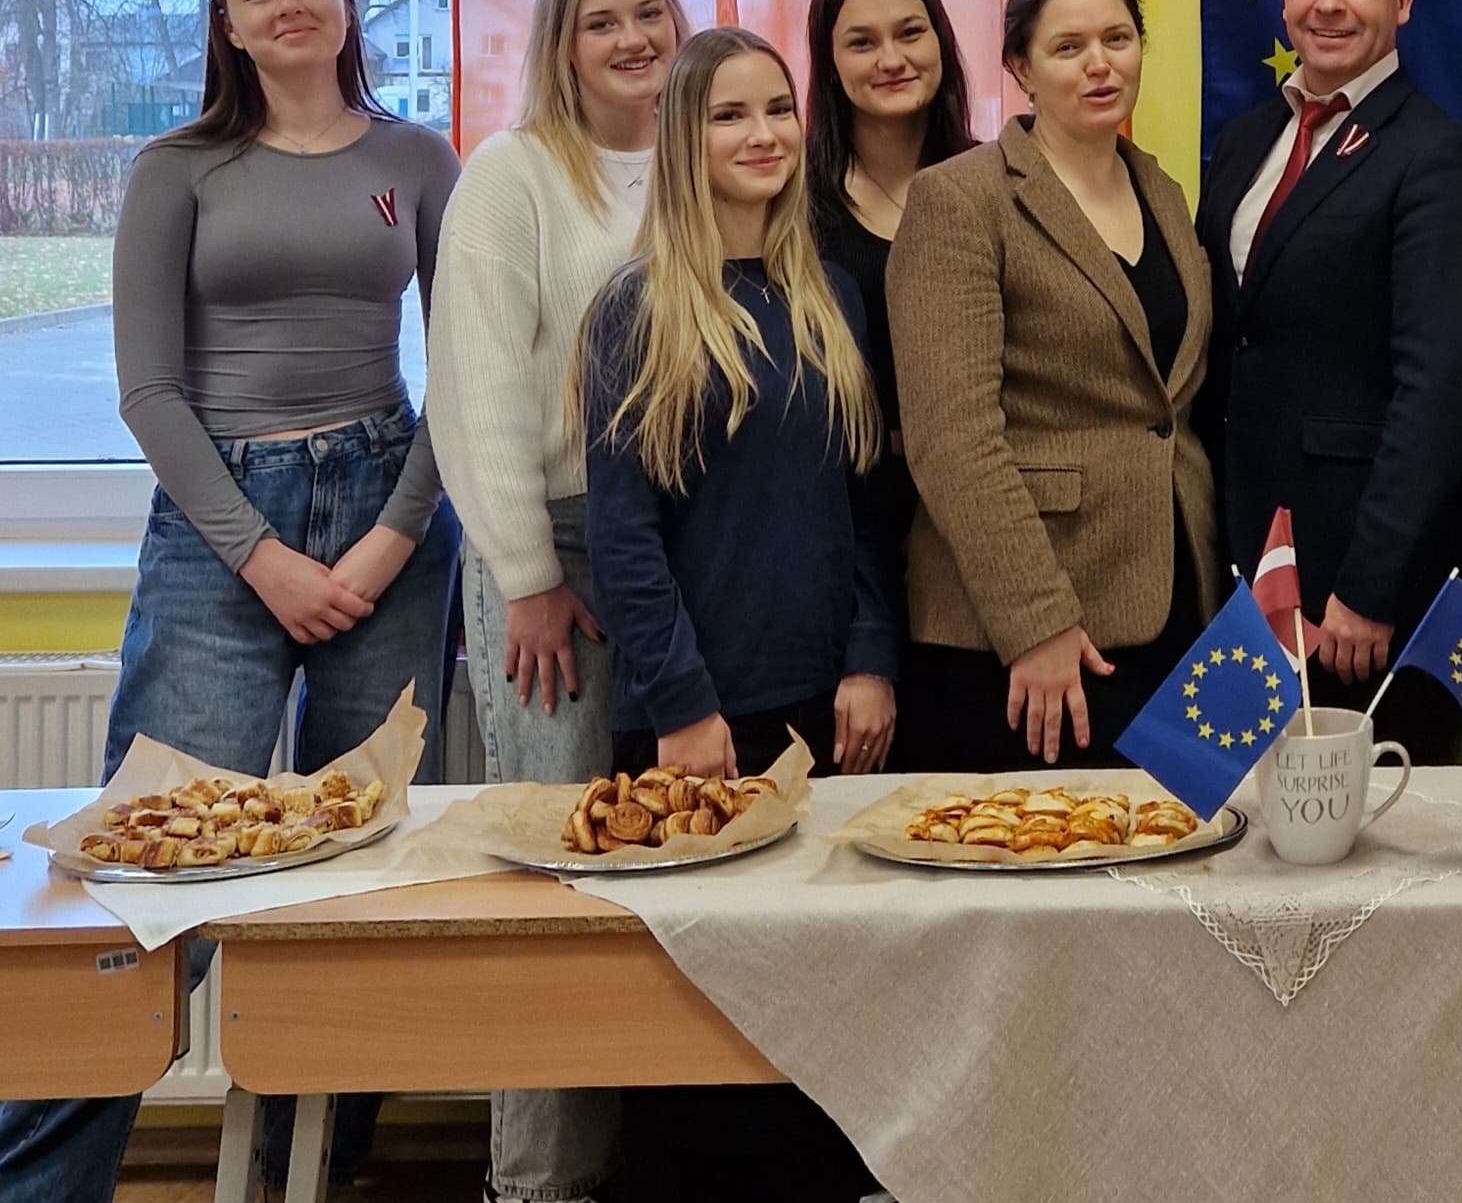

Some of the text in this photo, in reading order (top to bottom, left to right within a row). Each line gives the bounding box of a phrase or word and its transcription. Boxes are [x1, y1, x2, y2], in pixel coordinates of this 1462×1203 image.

[1276, 751, 1353, 771] LET LIFE
[1278, 772, 1351, 794] SURPRISE
[1281, 793, 1350, 824] YOU
